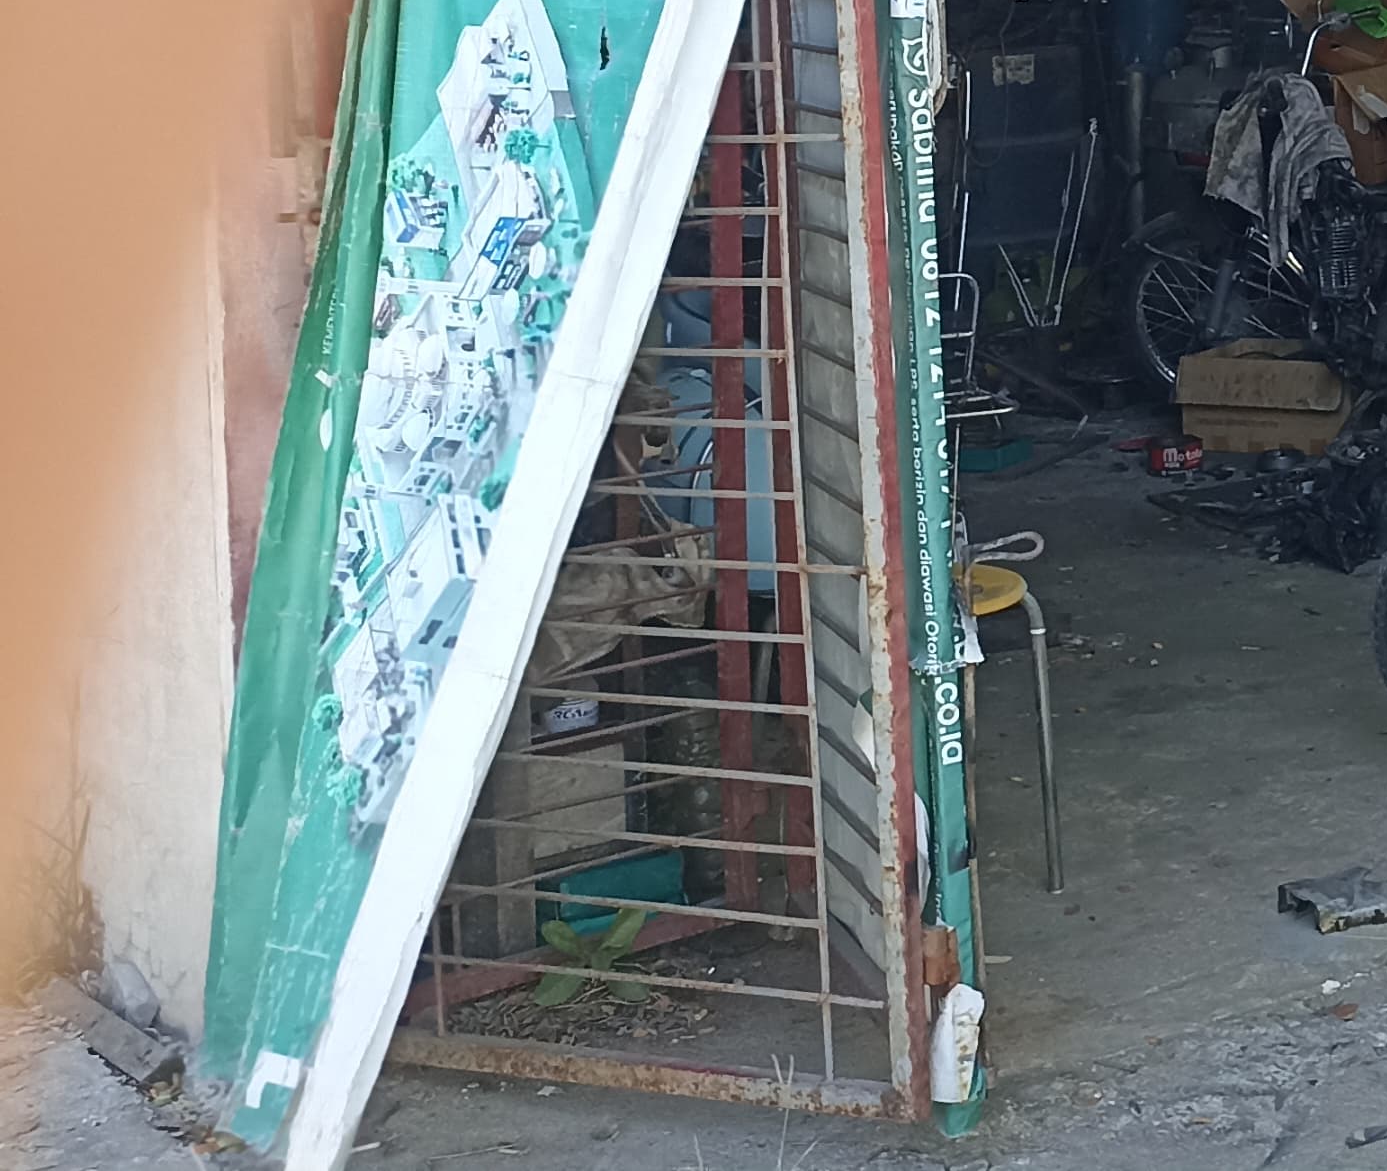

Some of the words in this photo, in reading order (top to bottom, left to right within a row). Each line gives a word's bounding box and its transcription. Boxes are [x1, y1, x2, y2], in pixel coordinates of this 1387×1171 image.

[913, 446, 925, 505] berizin
[917, 510, 929, 544] dan
[919, 548, 938, 616] diawasi
